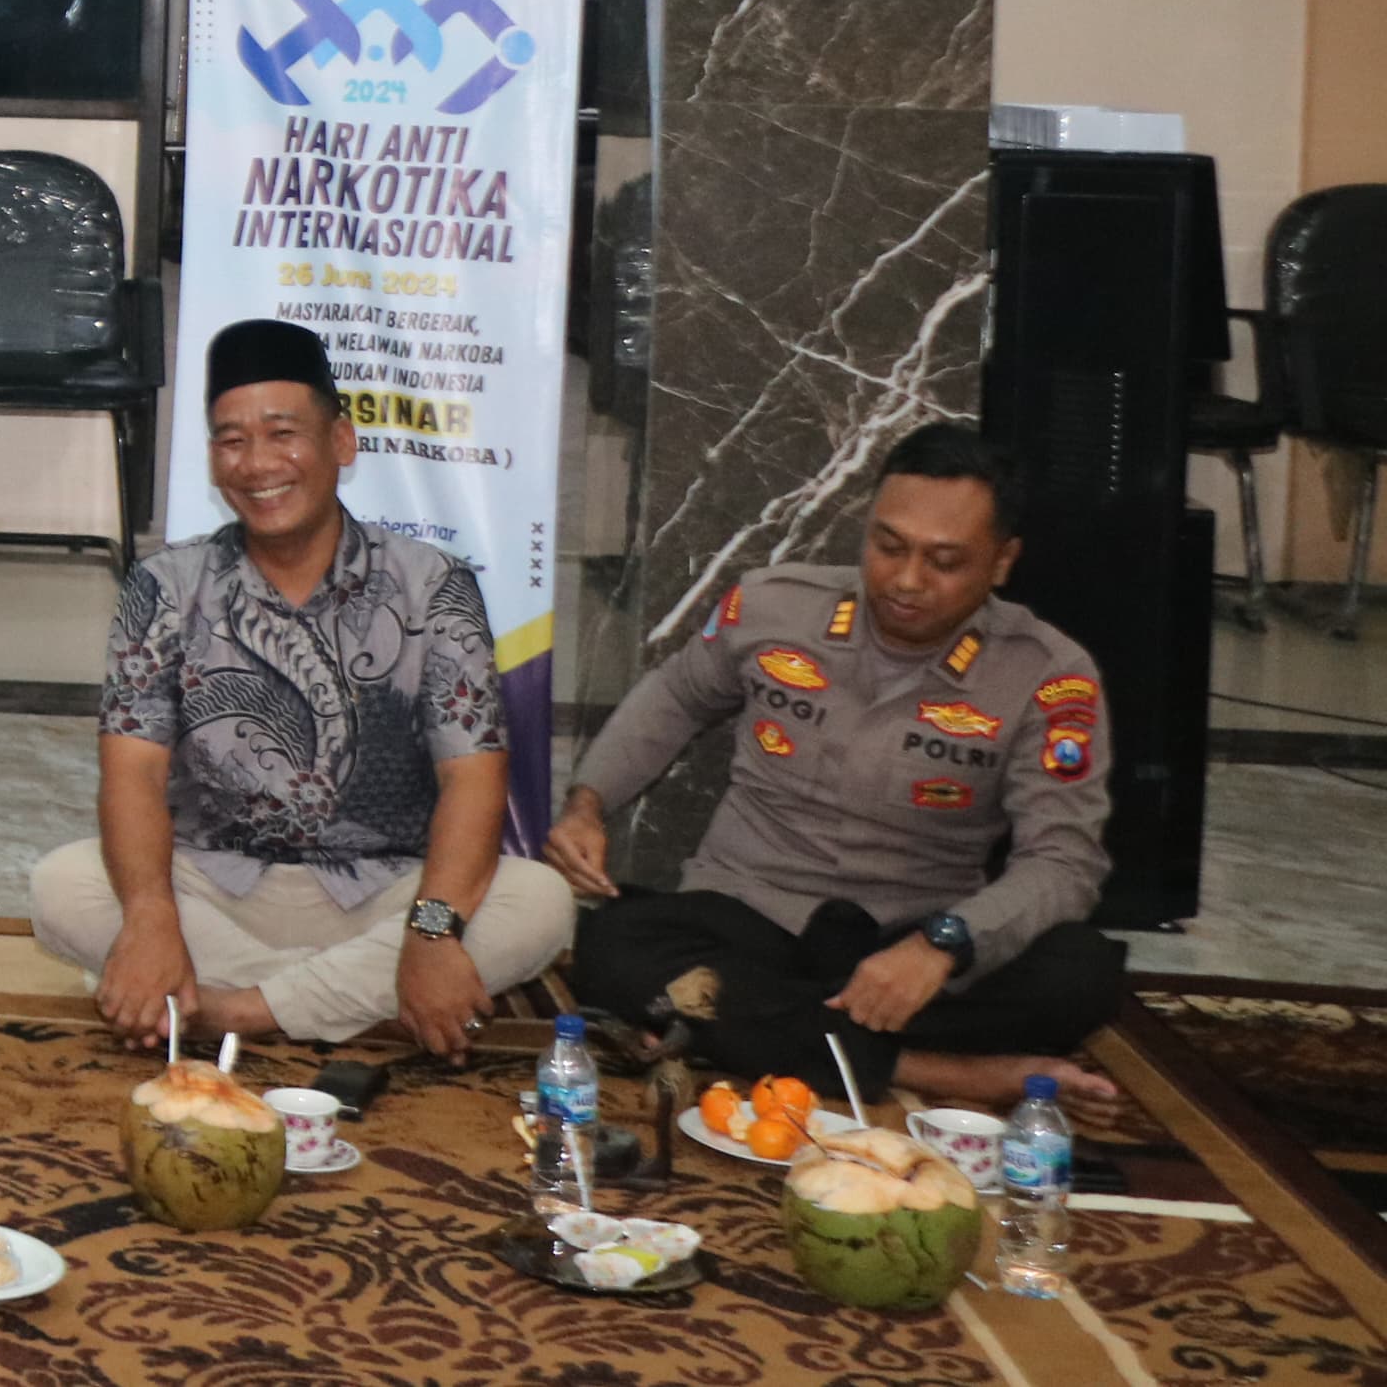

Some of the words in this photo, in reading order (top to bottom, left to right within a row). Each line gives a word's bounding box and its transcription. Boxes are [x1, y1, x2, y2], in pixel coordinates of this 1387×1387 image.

[343, 78, 408, 104] 2024
[283, 115, 368, 157] HARI
[377, 124, 469, 164] ANTI
[243, 158, 508, 219] NARKOTIKA
[232, 210, 514, 263] INTERNASIONAL
[279, 264, 313, 286] 26
[320, 264, 373, 290] Juni
[381, 271, 459, 297] 2024
[276, 301, 382, 325] MASYARAKAT
[387, 311, 480, 336] BERGERAK,
[336, 333, 412, 358] MELAWAN
[419, 342, 505, 364] NARKOBA
[393, 368, 484, 392] INDONESIA
[385, 438, 498, 464] NARKOBA
[751, 680, 826, 725] YOGI
[903, 733, 999, 768] POLRI
